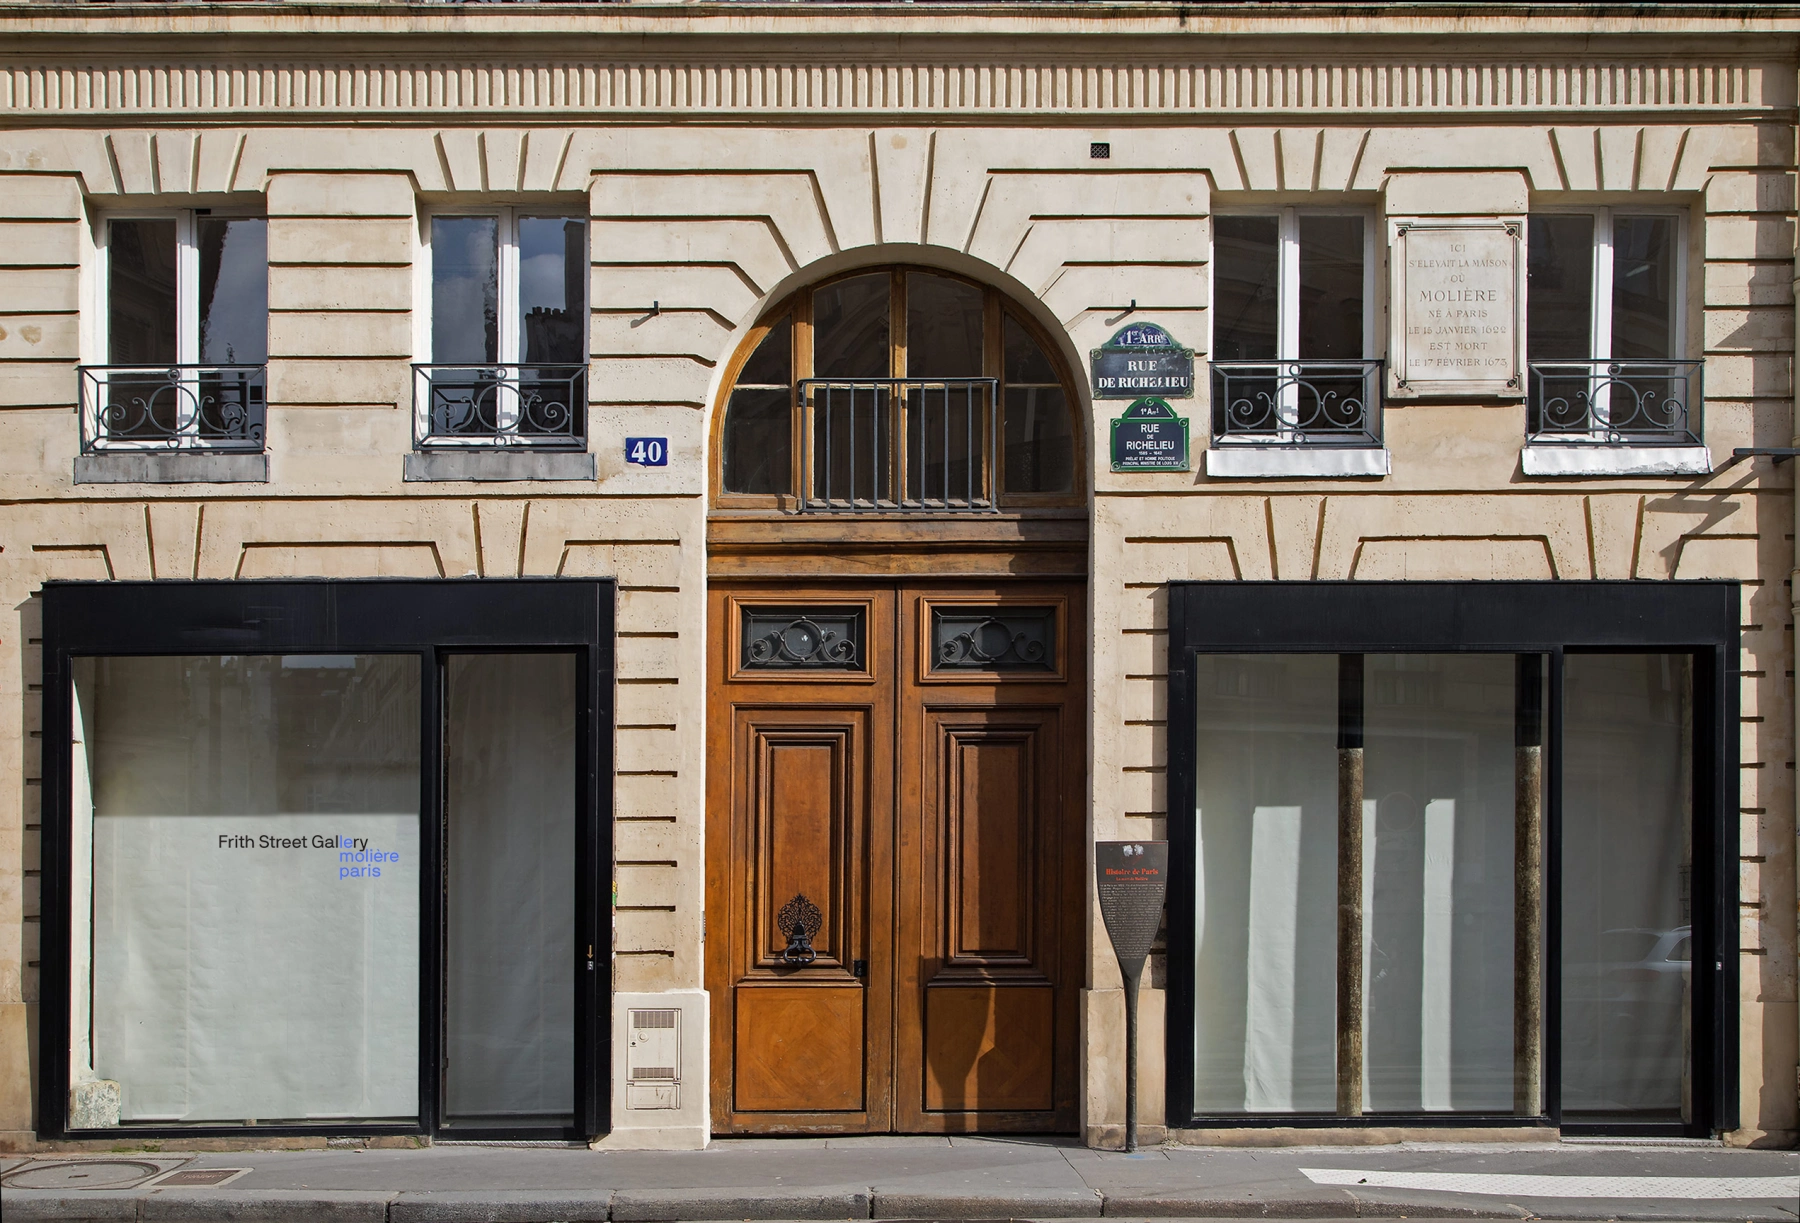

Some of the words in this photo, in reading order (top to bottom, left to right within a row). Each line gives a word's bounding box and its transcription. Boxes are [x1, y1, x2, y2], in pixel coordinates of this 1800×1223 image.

[1450, 244, 1466, 252] ICI
[1458, 259, 1469, 268] LA
[1472, 259, 1508, 268] MAISON
[1420, 288, 1497, 302] MOLIÈRE
[1428, 308, 1442, 318] NÉ
[1446, 308, 1452, 318] À
[1456, 310, 1488, 318] PARIS
[1408, 326, 1420, 334] LE
[1424, 326, 1432, 334] 15
[1436, 326, 1477, 334] JANVIER
[1482, 325, 1506, 334] 1622
[1430, 342, 1451, 350] EST
[1455, 342, 1488, 350] MORT
[1128, 360, 1158, 372] RUE
[1436, 358, 1480, 366] FÉVRIER
[1098, 377, 1116, 388] DE
[1140, 424, 1160, 432] RUE
[1126, 441, 1174, 450] RICHELIEU
[632, 441, 662, 462] 40
[218, 835, 254, 848] Frith
[259, 835, 308, 848] Street
[312, 835, 368, 852] Gallery
[340, 849, 399, 862] molière
[340, 864, 381, 880] paris
